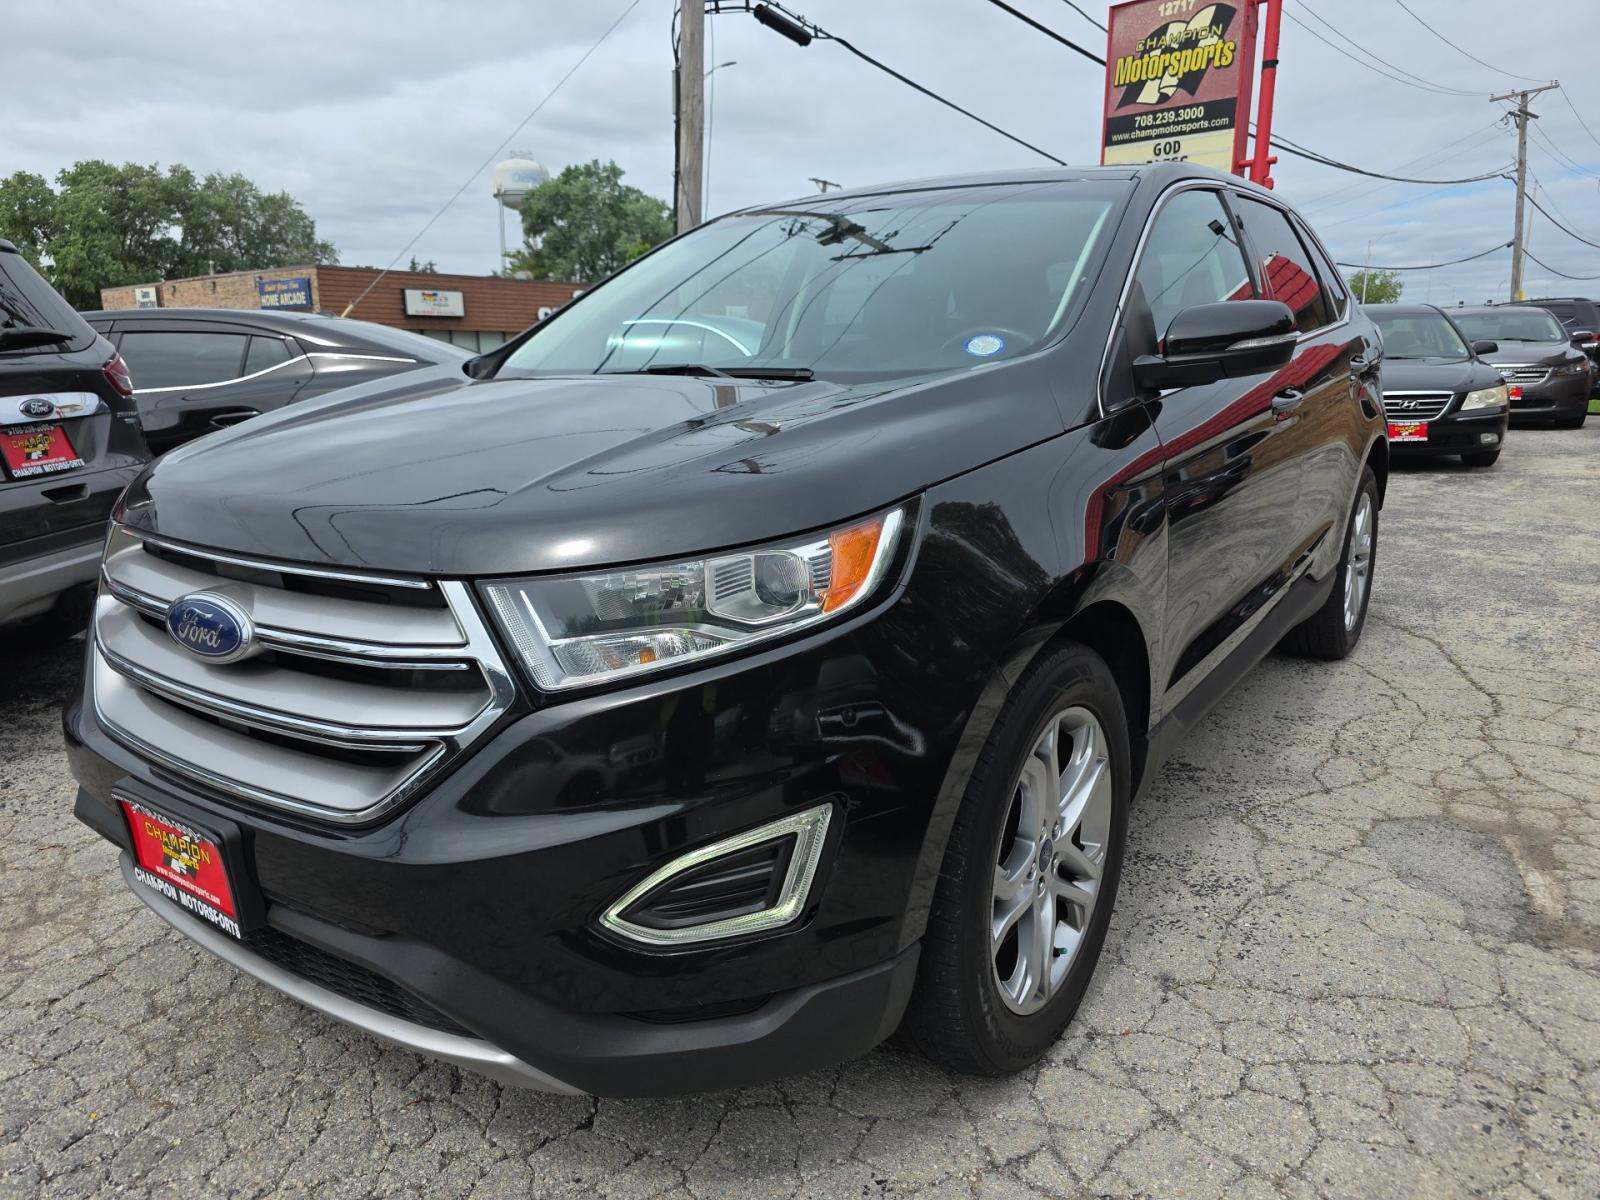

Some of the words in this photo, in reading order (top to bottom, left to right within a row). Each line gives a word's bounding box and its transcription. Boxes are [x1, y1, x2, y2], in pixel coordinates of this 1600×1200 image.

[1136, 24, 1223, 52] CHAMPION
[1114, 39, 1236, 87] Motorsports
[1111, 117, 1229, 142] www.champmotorsports.com
[1134, 106, 1205, 128] 708.239.3000
[1153, 140, 1181, 157] GOD
[261, 294, 280, 307] HOME
[280, 291, 306, 305] ARCADE
[11, 466, 44, 478] CHAMPION
[178, 606, 224, 648] Ford
[144, 821, 211, 865] CHAMPION
[134, 866, 178, 901] CHAMPION
[179, 889, 241, 940] MOTORSPORTS
